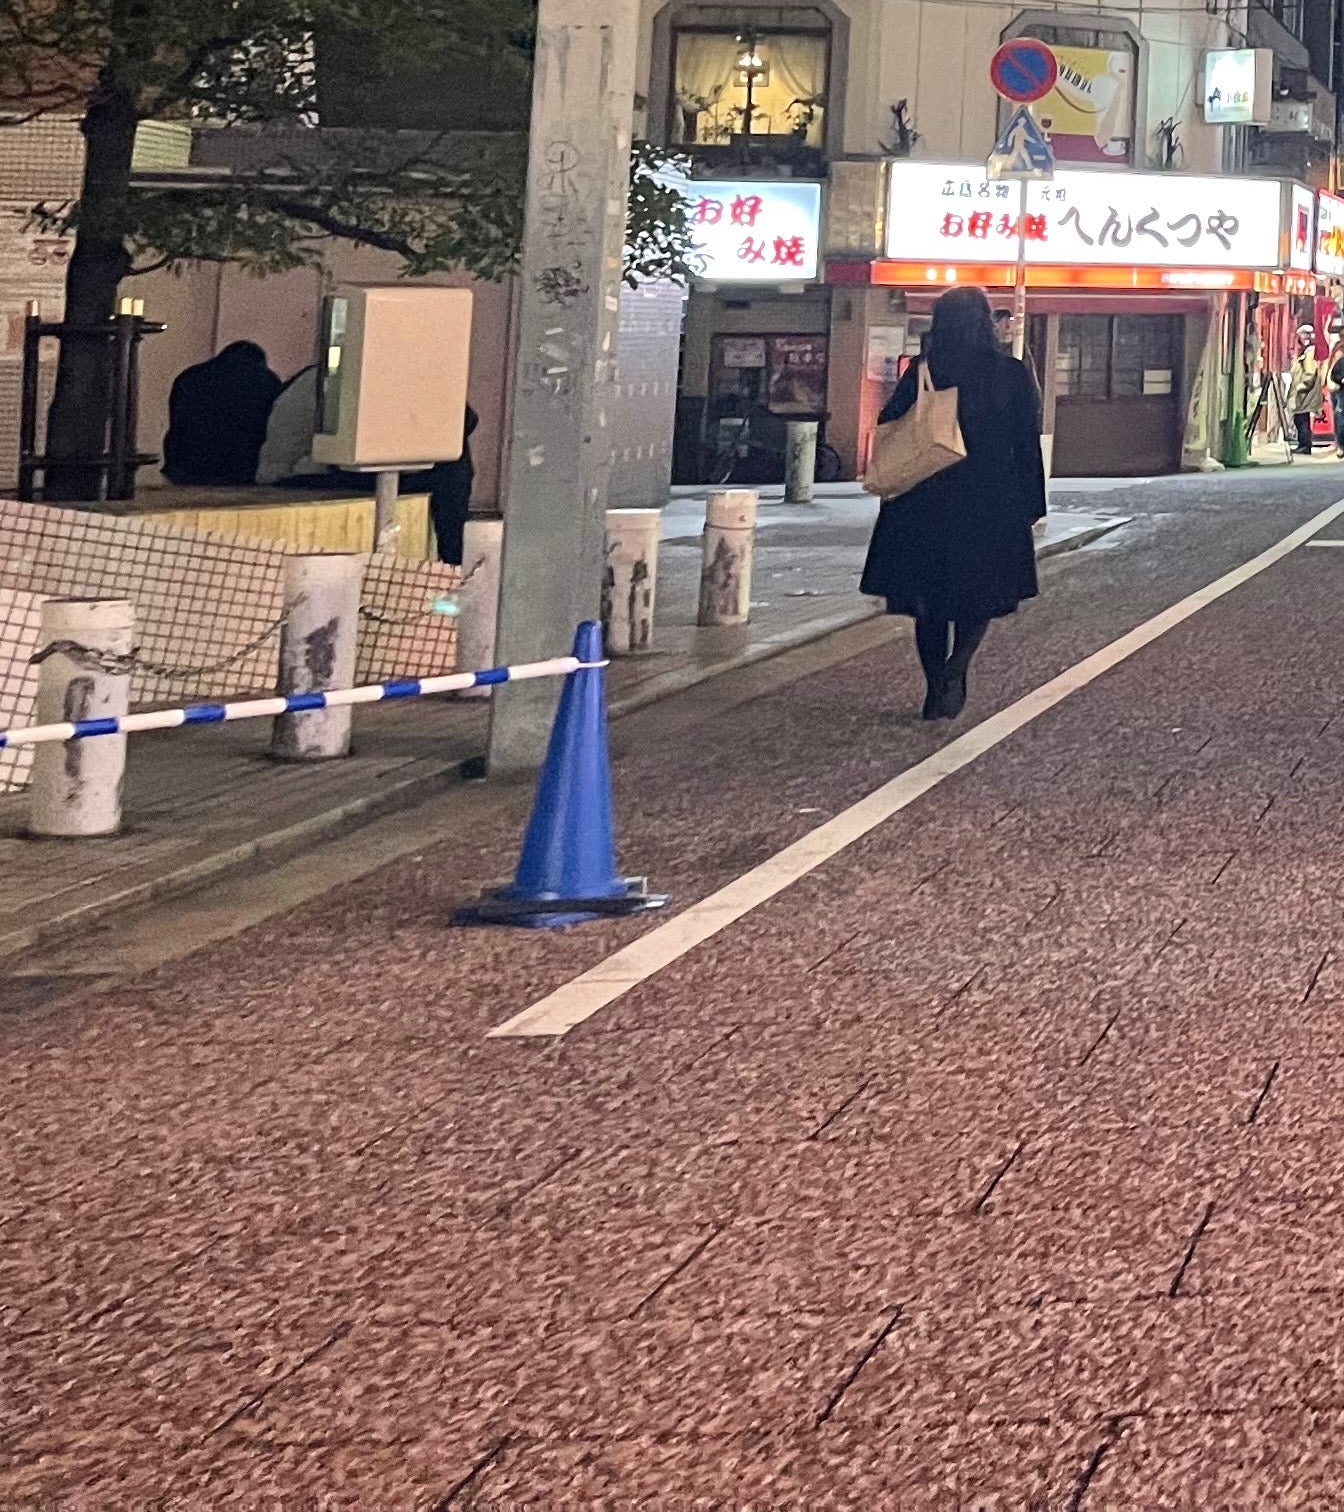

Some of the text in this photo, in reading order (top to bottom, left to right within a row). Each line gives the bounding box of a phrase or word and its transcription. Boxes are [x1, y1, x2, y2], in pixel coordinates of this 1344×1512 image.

[1057, 205, 1240, 251] へんくつや
[737, 235, 805, 267] み焼
